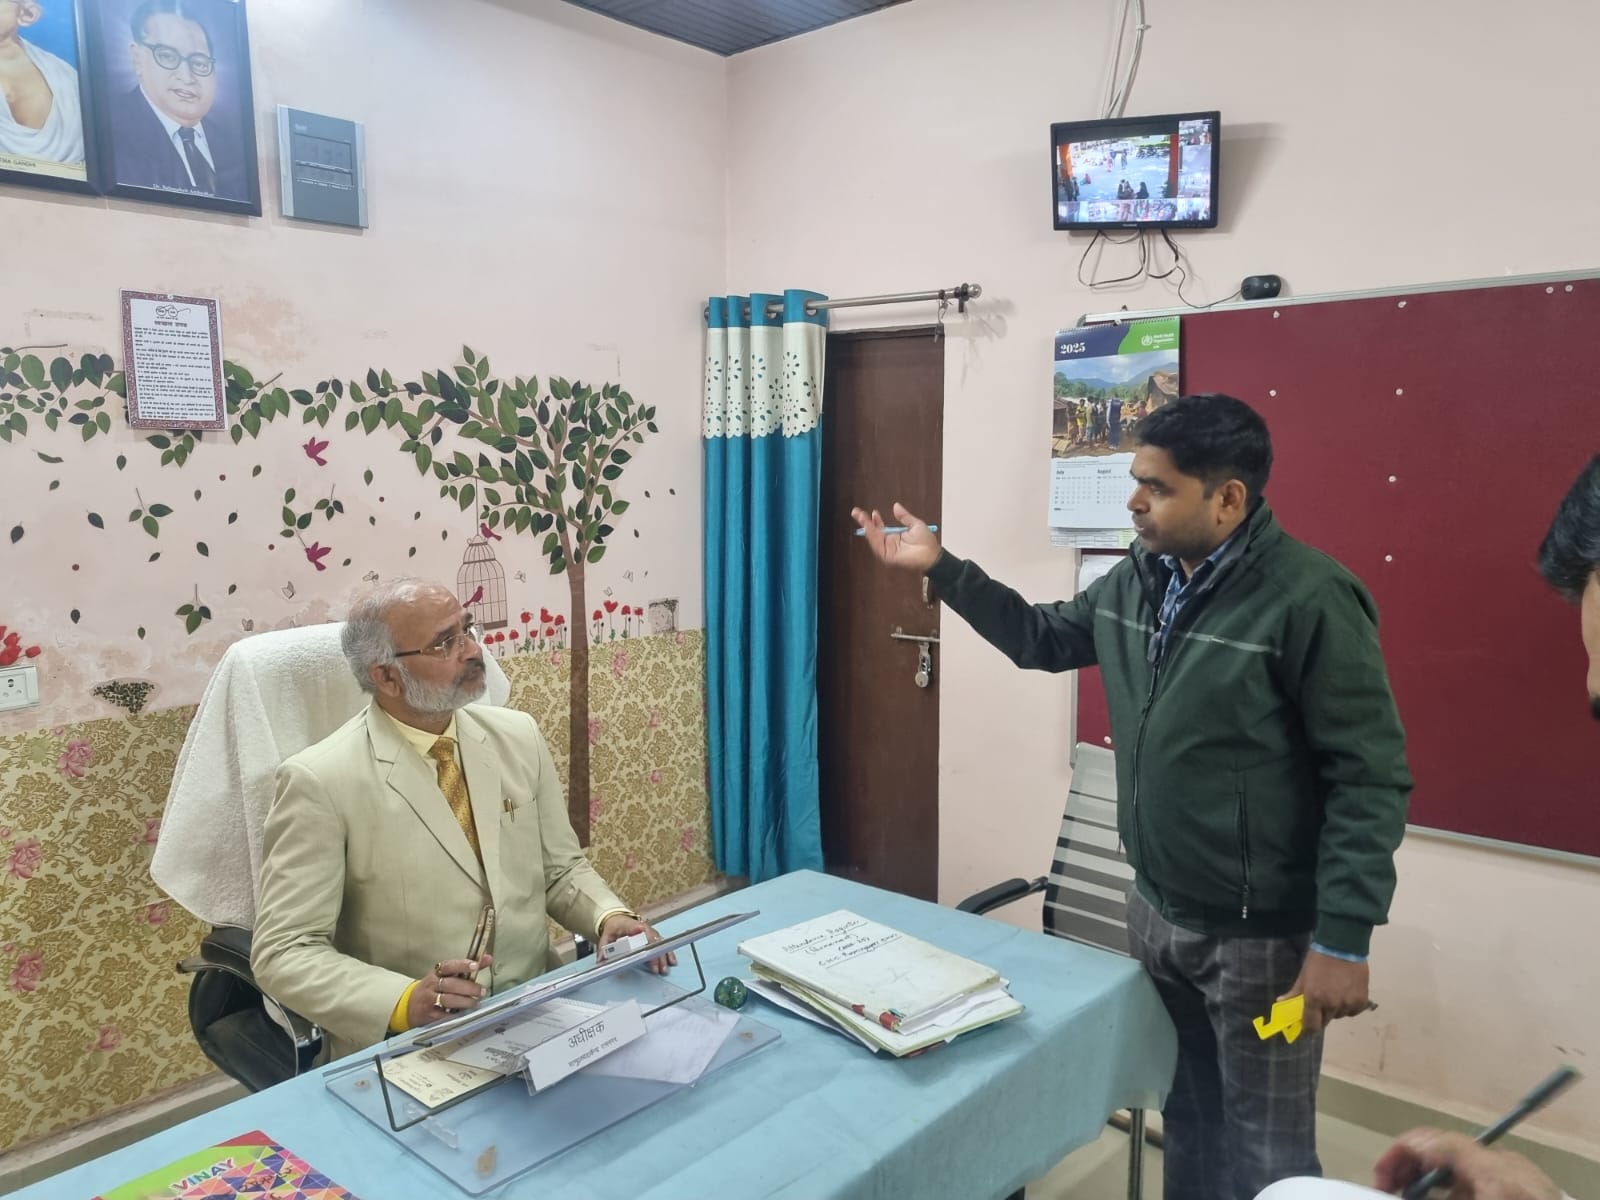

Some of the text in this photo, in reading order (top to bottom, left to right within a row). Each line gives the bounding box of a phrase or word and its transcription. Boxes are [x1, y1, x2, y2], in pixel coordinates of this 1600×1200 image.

[1060, 342, 1086, 354] 2025
[568, 1020, 605, 1048] अधीक्षक
[171, 1157, 235, 1192] VINAY
